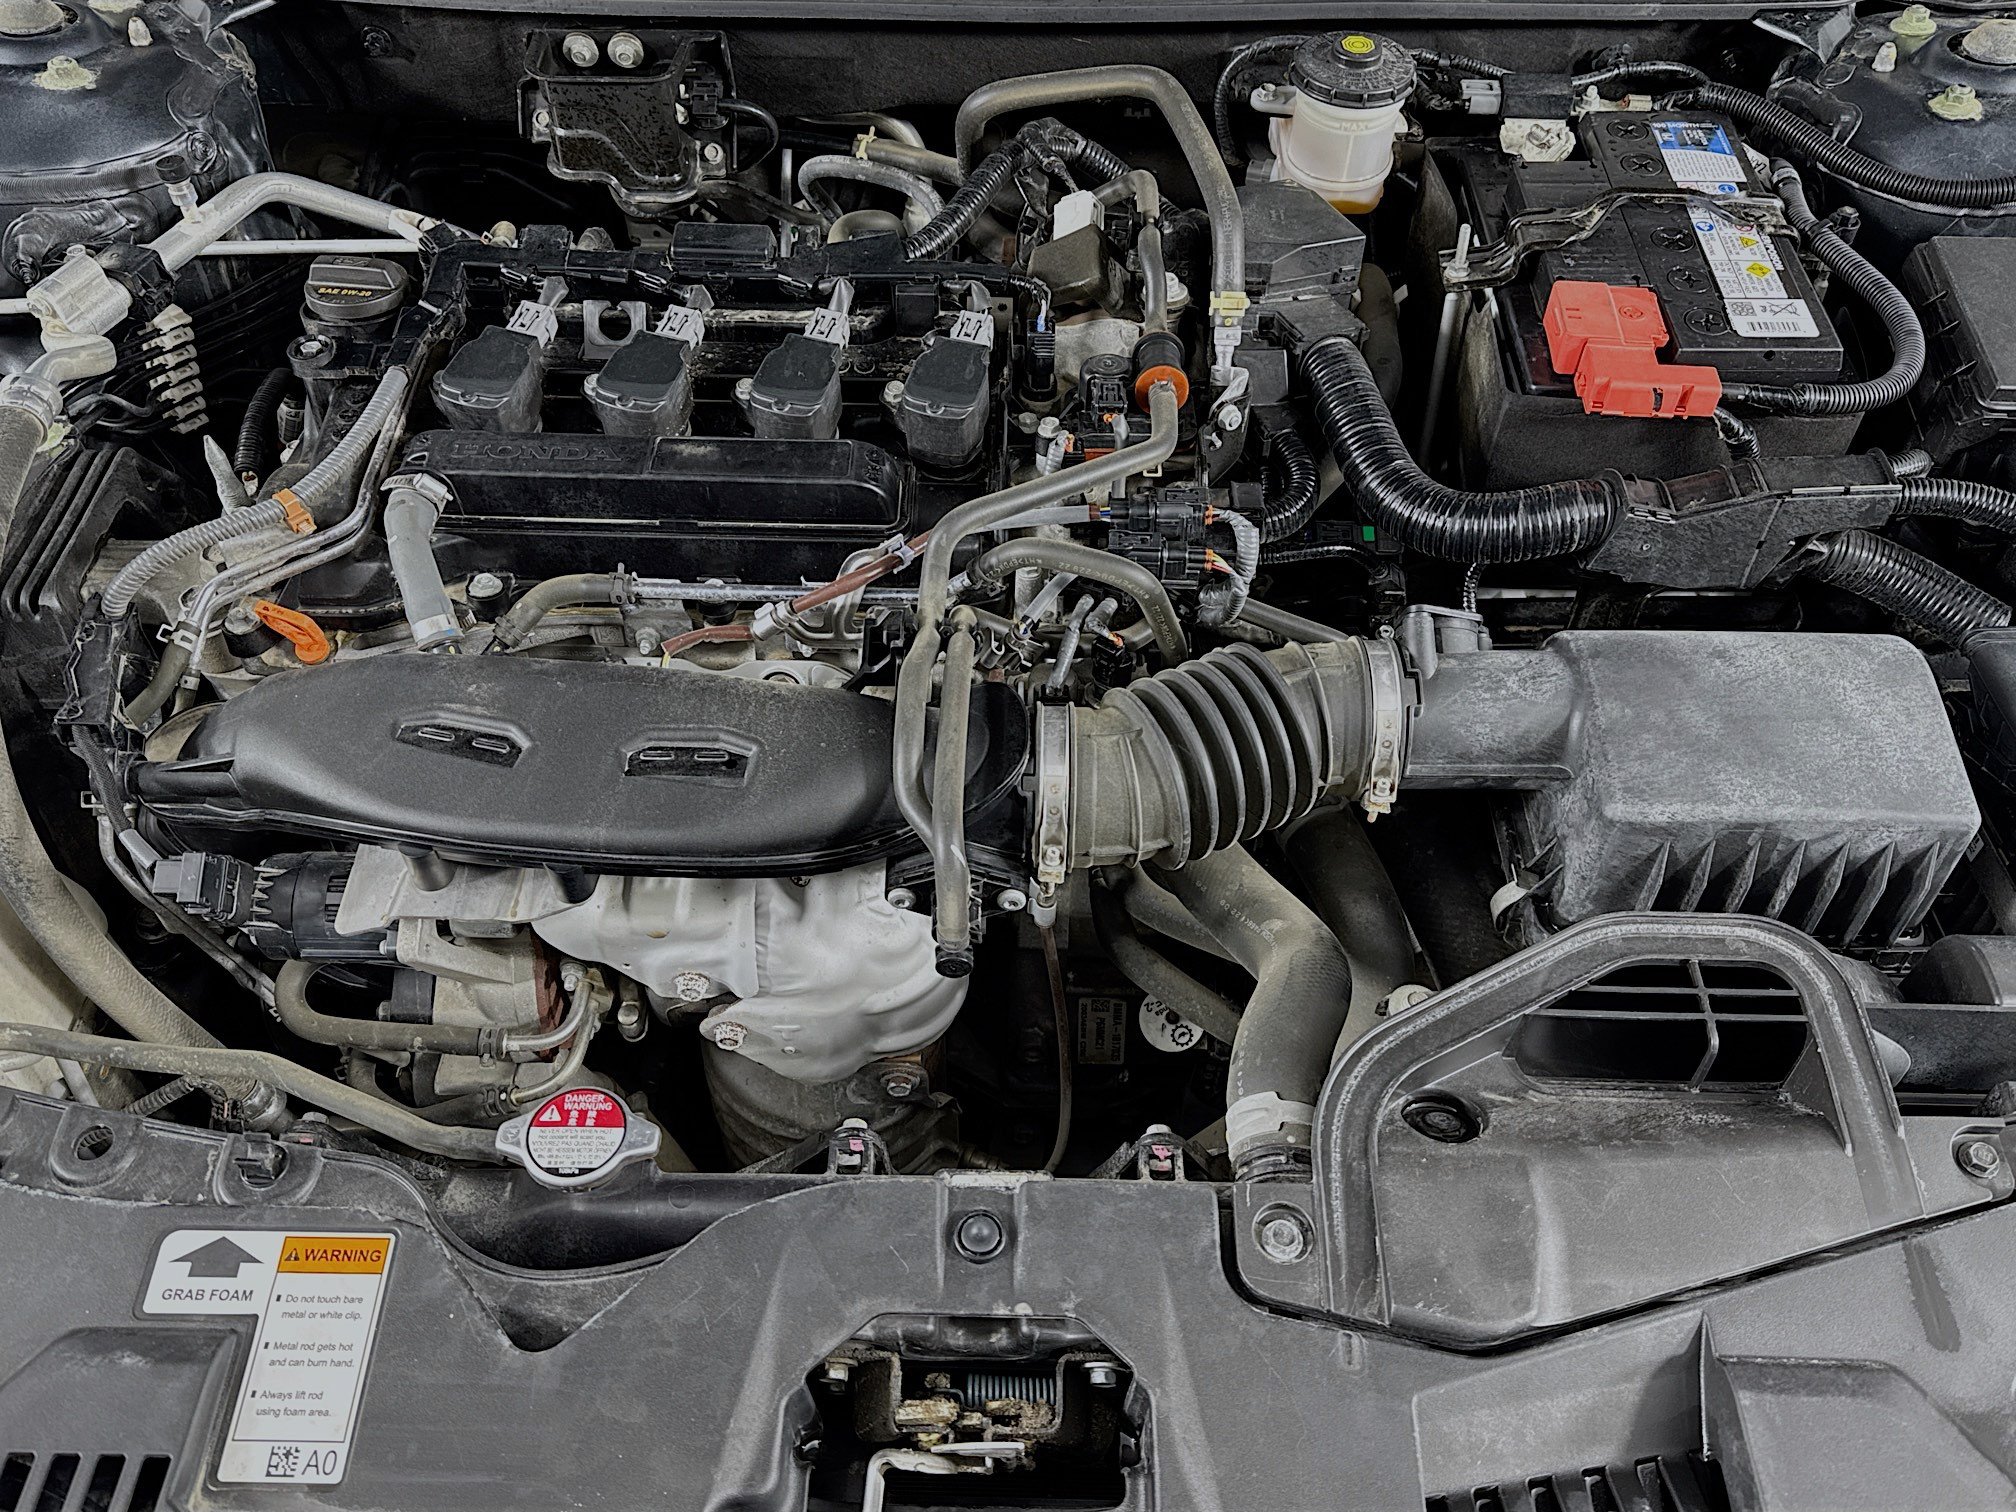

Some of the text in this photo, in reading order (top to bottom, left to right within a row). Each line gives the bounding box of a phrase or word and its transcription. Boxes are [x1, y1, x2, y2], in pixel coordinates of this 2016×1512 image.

[1341, 121, 1367, 132] MAX
[317, 287, 373, 297] SAE 0W-20
[450, 441, 622, 462] HONDA
[565, 1094, 606, 1103] DANGER
[563, 1102, 612, 1111] WARNUNG
[304, 1249, 382, 1262] WARNING
[161, 1288, 254, 1301] GRAB FOAM
[285, 1294, 364, 1304] Do not touch bare
[281, 1310, 307, 1319] metal
[320, 1310, 343, 1319] white
[344, 1310, 363, 1321] clip.
[273, 1341, 354, 1353] Metal rod gets hot
[268, 1358, 355, 1368] and can burn hand.
[260, 1390, 324, 1401] Always lift rod
[256, 1407, 332, 1417] using foam area.
[301, 1449, 338, 1476] A0
